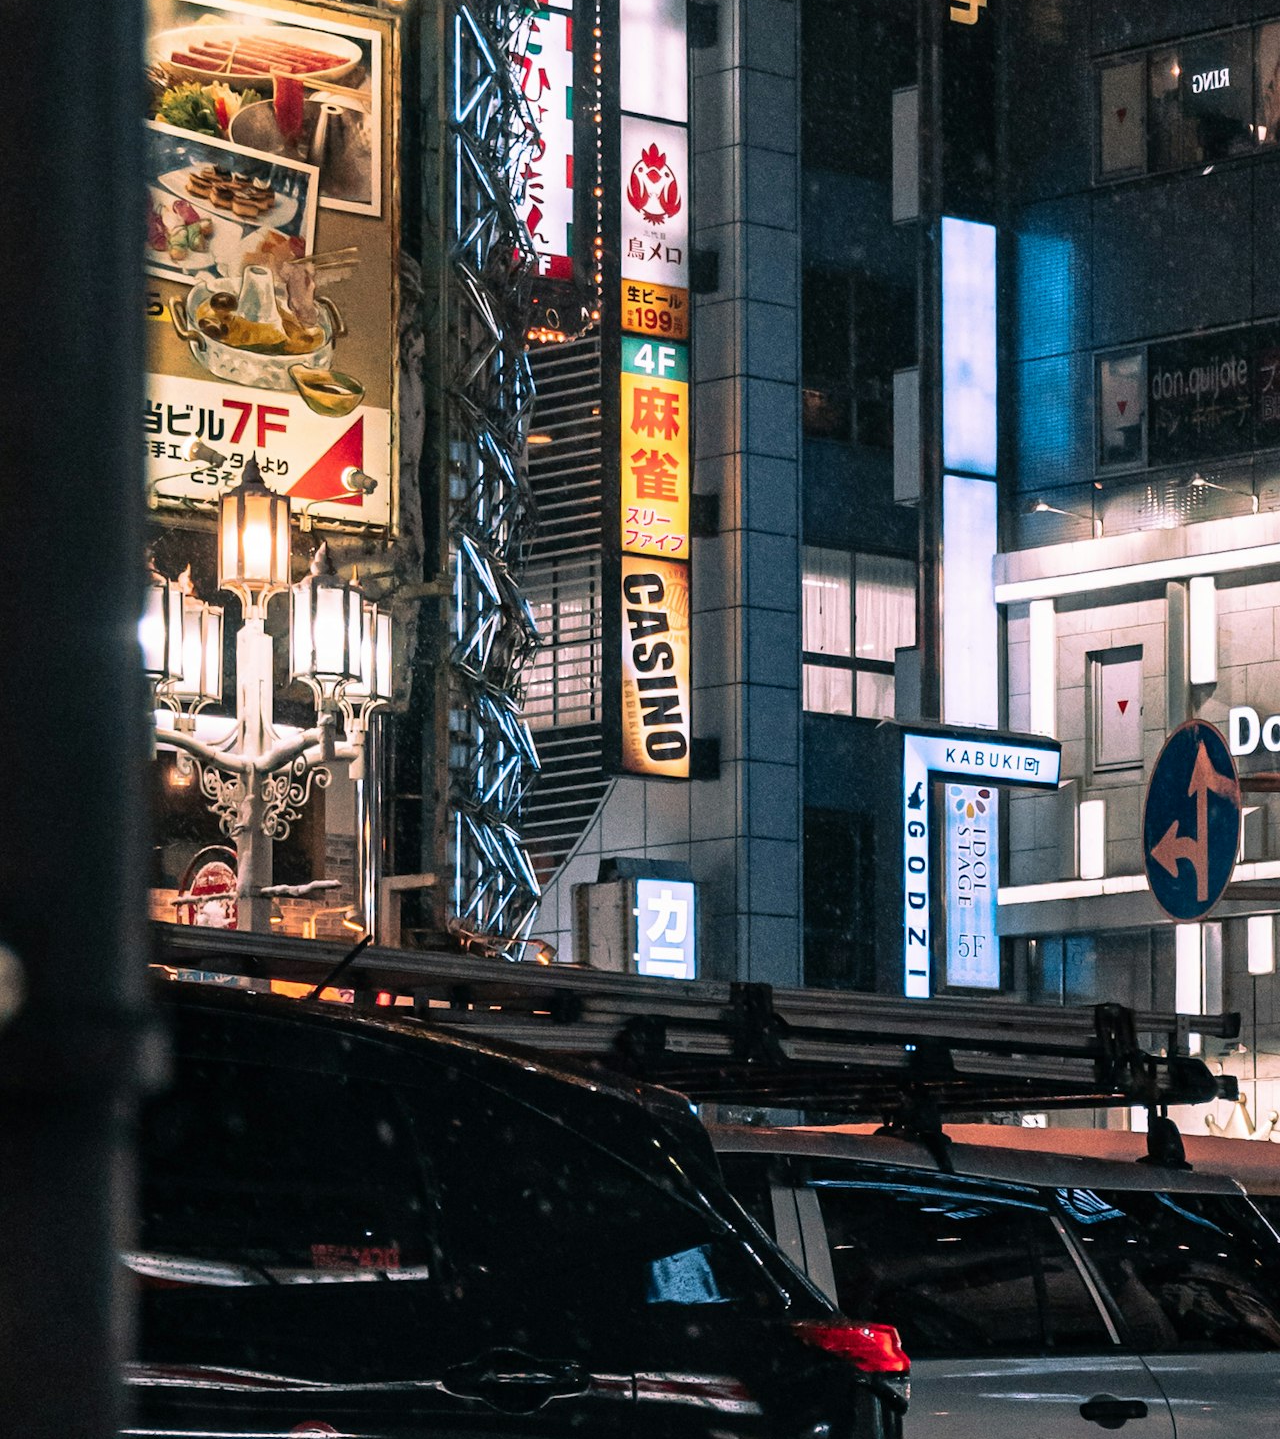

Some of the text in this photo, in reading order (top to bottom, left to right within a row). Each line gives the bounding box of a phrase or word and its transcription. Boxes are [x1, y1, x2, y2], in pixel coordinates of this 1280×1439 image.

[627, 236, 682, 266] 鳥メロ
[627, 285, 682, 310] 生ビール
[635, 306, 672, 333] 199
[633, 343, 677, 376] 4F
[629, 386, 680, 504] 麻雀
[626, 508, 671, 526] スリー
[625, 528, 686, 554] ファイブ
[623, 573, 688, 762] CASINO
[957, 825, 972, 907] STAGE
[973, 827, 987, 891] IDOL
[957, 934, 986, 959] 5F
